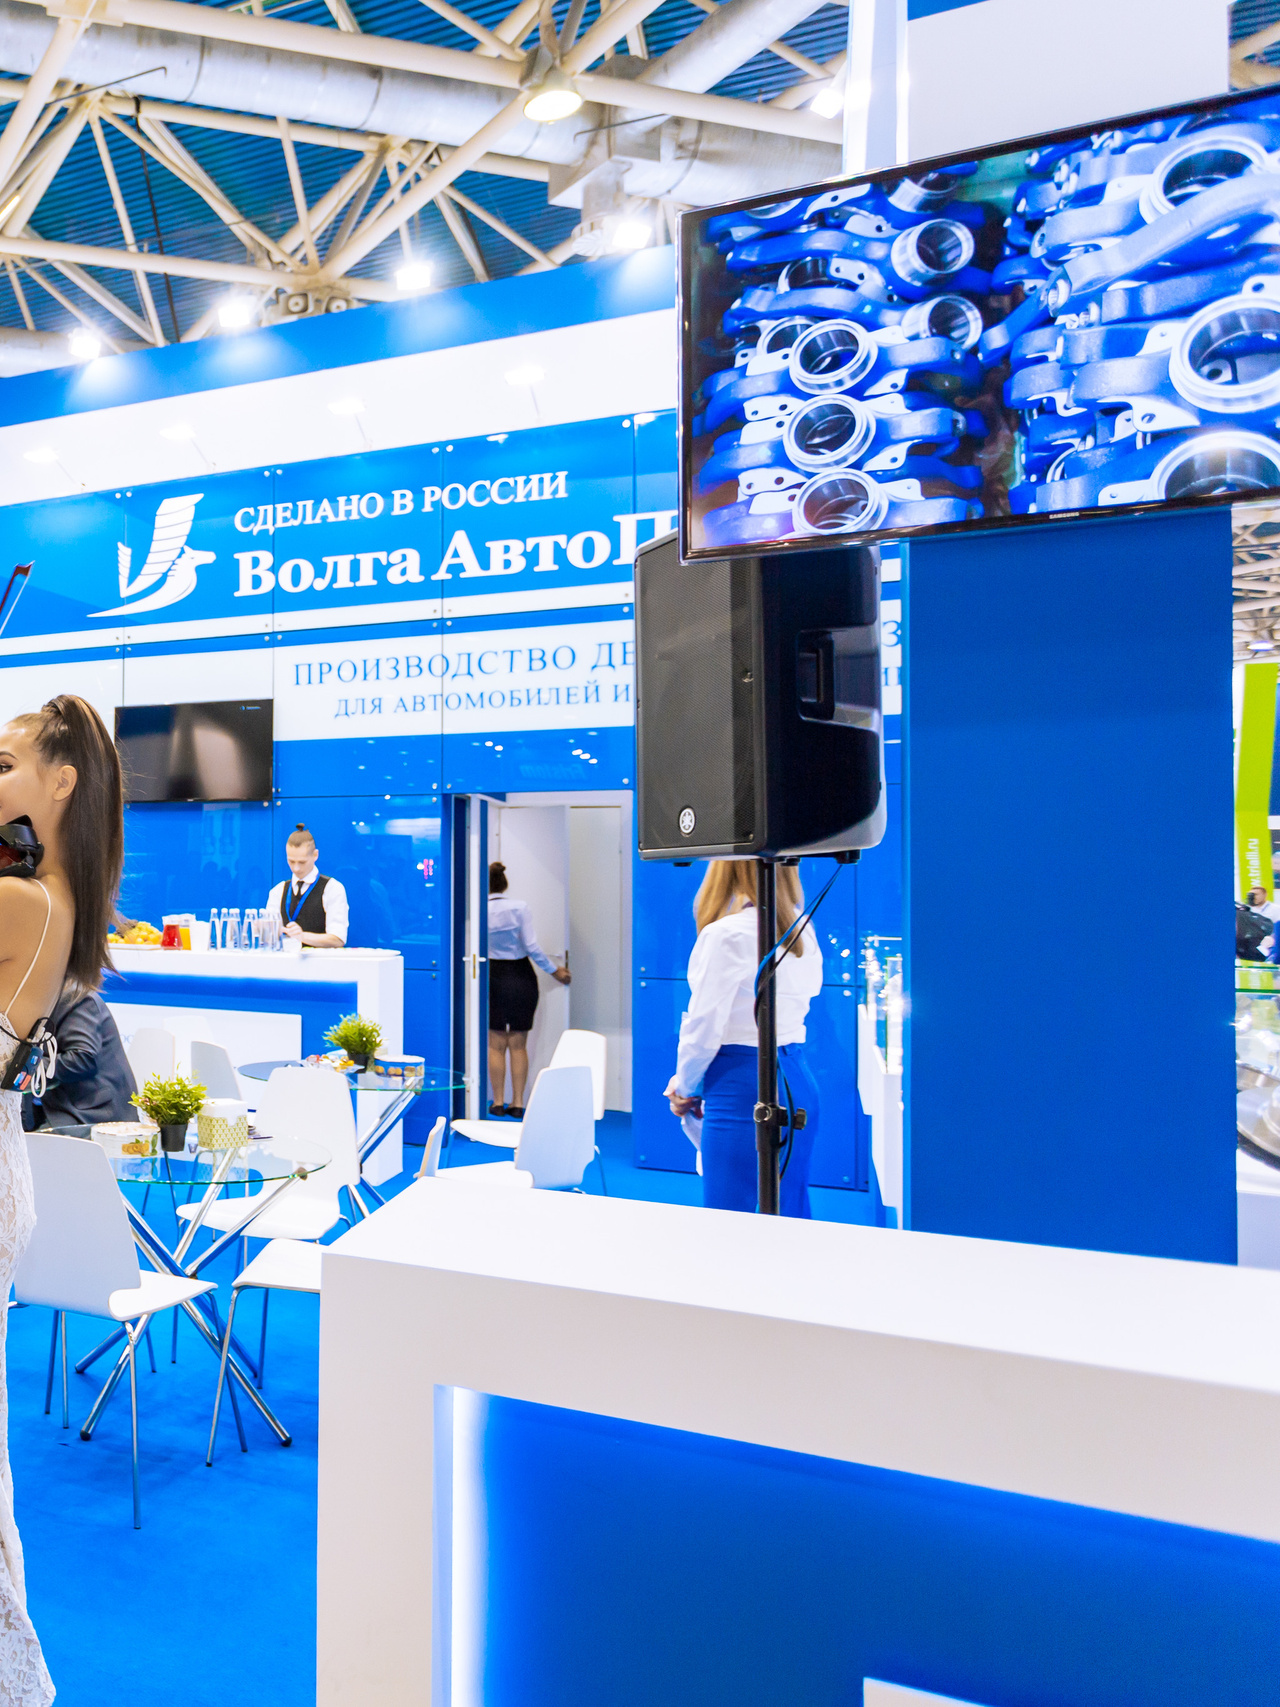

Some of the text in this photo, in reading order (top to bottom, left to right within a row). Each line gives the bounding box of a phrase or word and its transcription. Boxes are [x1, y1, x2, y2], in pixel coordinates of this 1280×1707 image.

[234, 471, 568, 536] СДЕЛАНО В РОССИИ
[233, 510, 678, 597] Волга АвтоП
[294, 640, 635, 687] ПРОИЗВОДСТВО ДЕ
[334, 697, 383, 719] ДЛЯ
[393, 679, 600, 714] АВТОМОБИЛЕЙ
